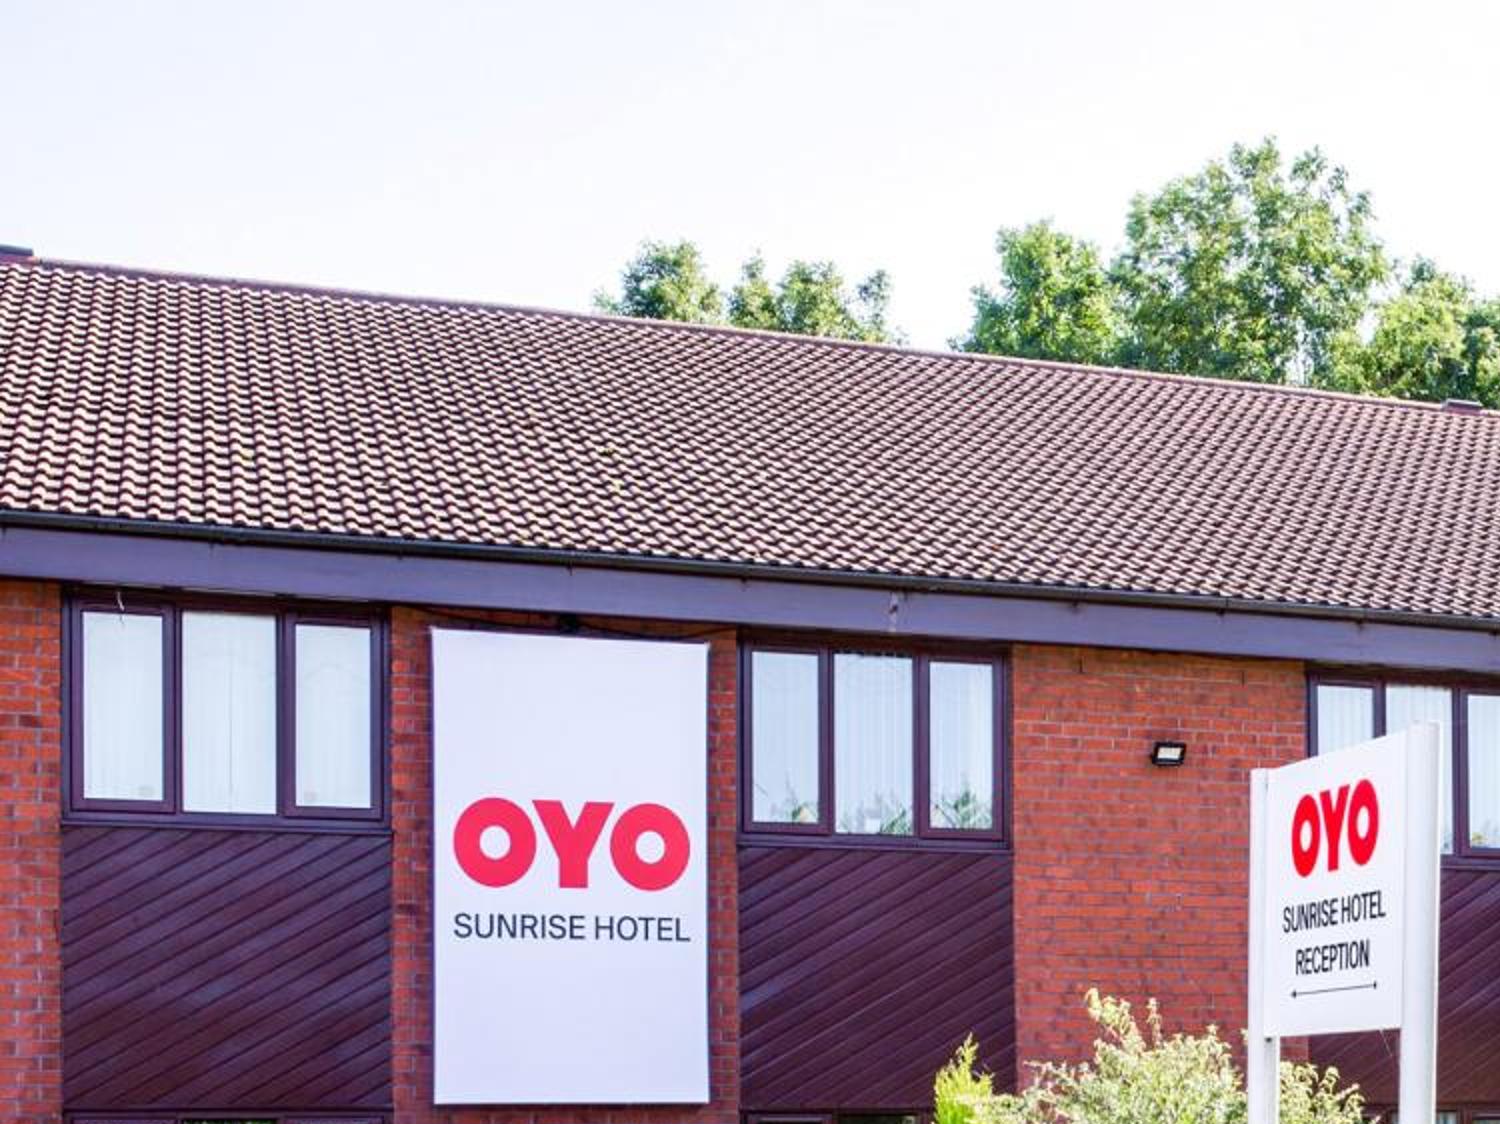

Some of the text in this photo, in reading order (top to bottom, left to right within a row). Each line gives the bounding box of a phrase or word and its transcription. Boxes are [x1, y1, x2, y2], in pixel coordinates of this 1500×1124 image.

[452, 797, 690, 892] OYO
[1290, 779, 1380, 878] OYO
[453, 912, 691, 942] SUNRISE HOTEL
[1282, 890, 1386, 933] SUNRISE HOTEL
[1295, 939, 1370, 975] RECEPTION
